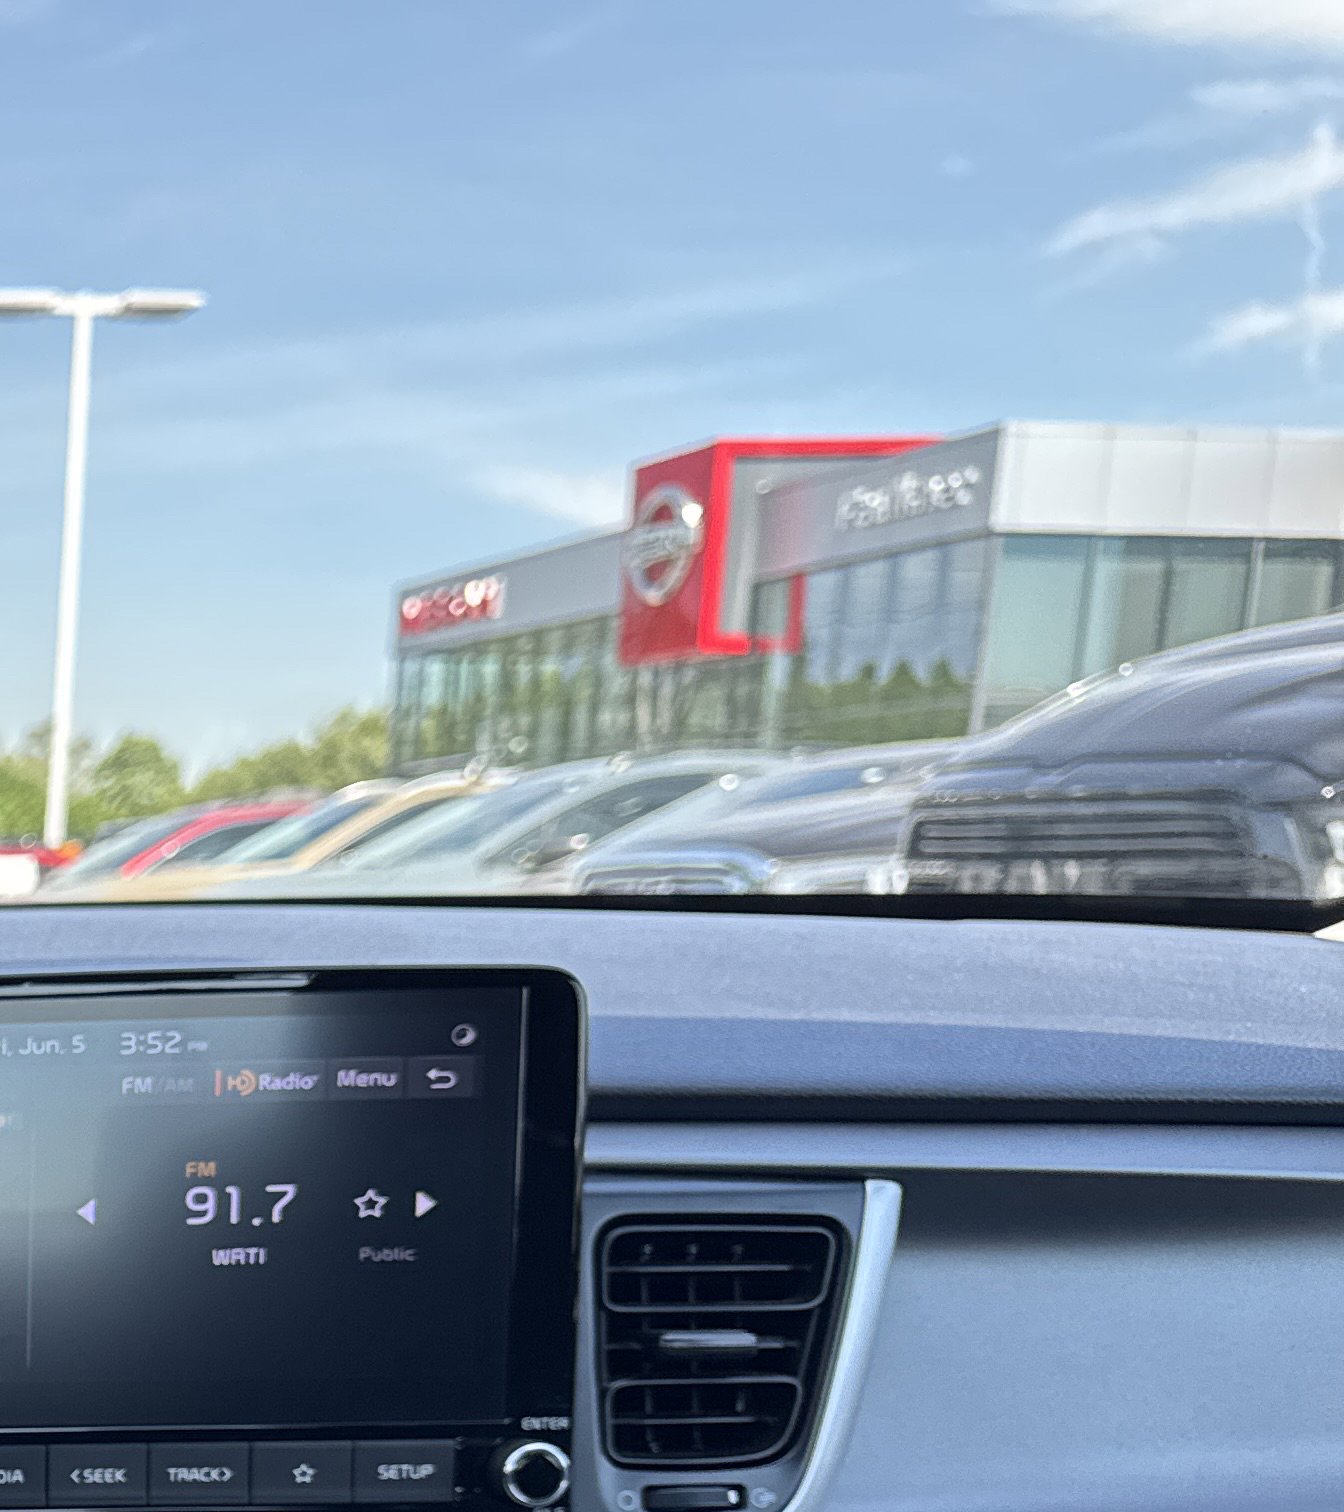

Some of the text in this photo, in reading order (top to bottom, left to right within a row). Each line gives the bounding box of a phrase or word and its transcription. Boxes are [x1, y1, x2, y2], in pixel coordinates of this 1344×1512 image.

[71, 1034, 86, 1054] 5
[120, 1031, 181, 1055] 3:52
[337, 1069, 398, 1089] Menu
[185, 1160, 216, 1178] FM
[185, 1184, 298, 1226] 91.7
[358, 1246, 418, 1263] Public
[521, 1416, 570, 1431] ENTER
[377, 1463, 435, 1480] SETUP
